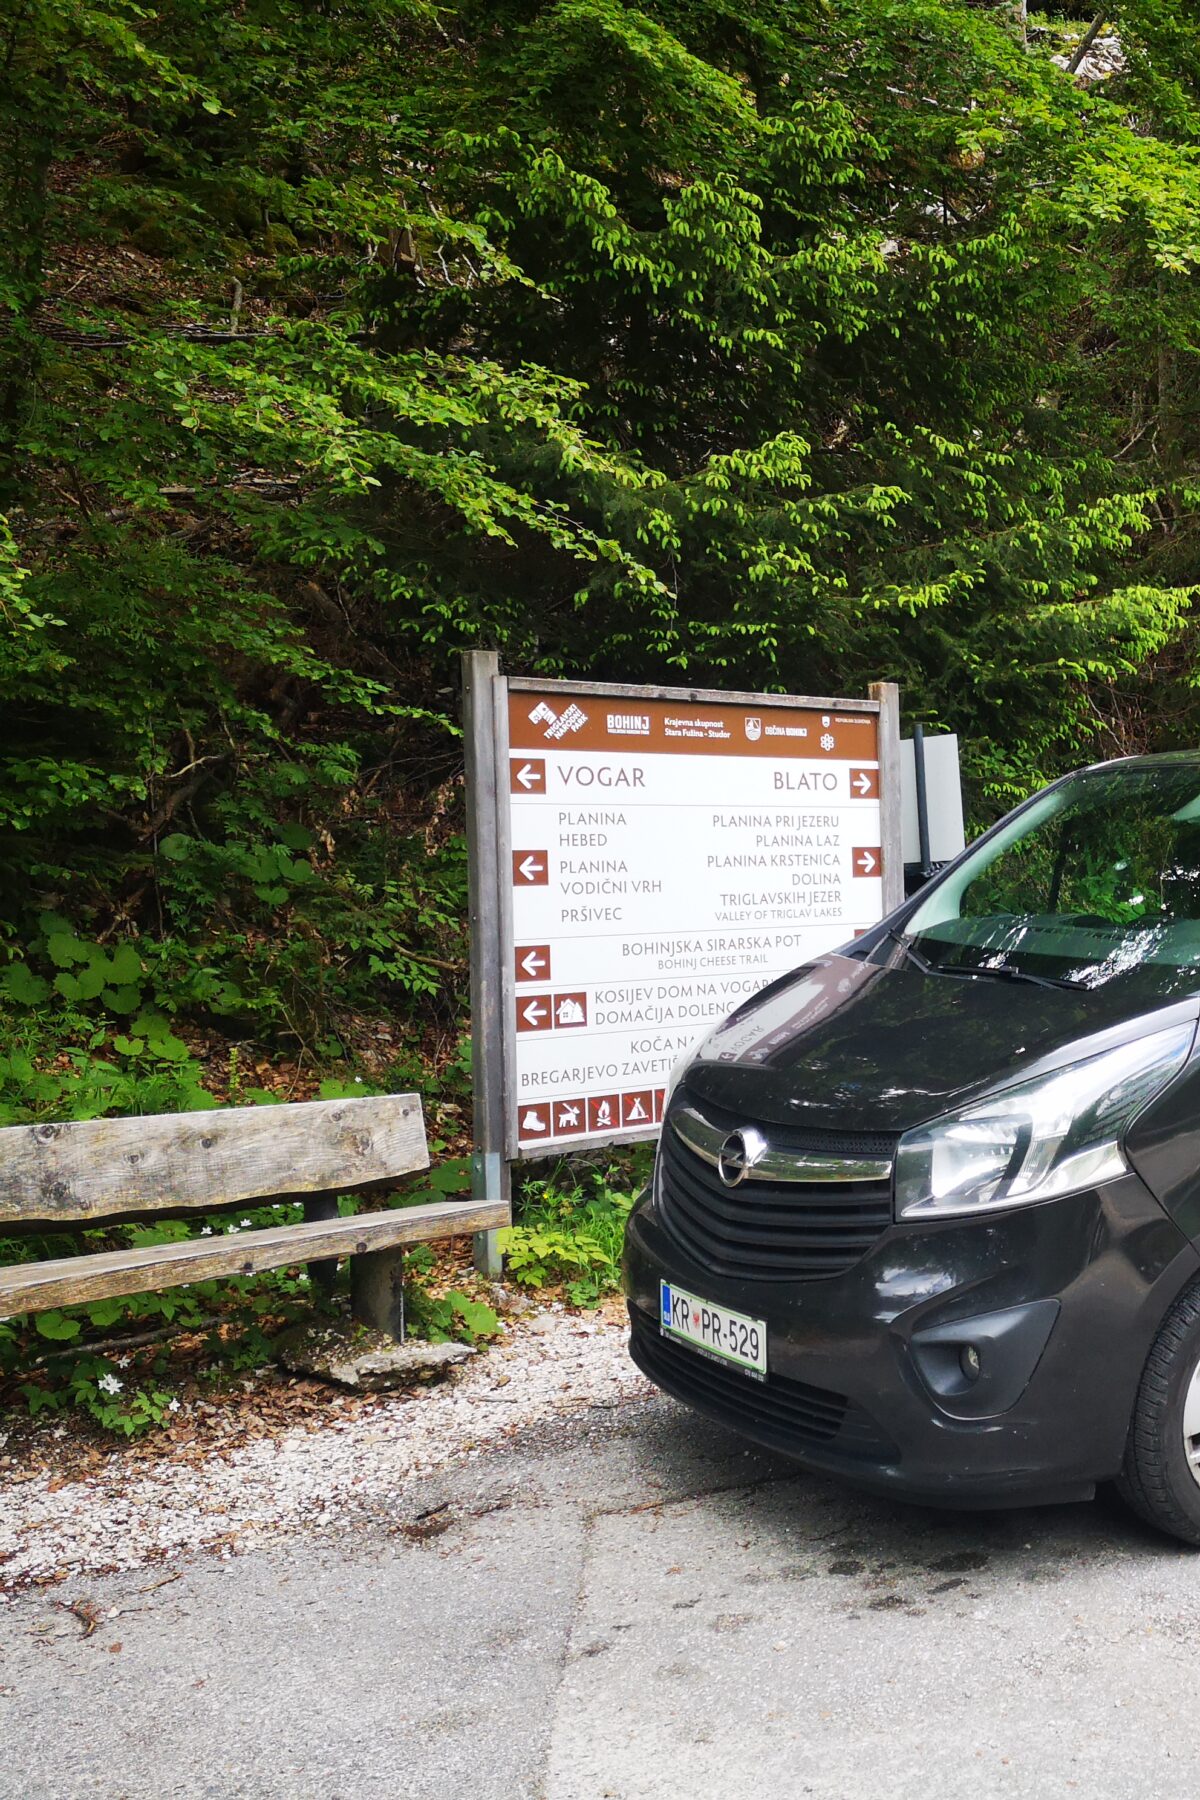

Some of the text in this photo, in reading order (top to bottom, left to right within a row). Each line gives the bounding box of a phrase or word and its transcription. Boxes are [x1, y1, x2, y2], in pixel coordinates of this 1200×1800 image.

[543, 703, 578, 739] TRIGLAVSKI
[553, 709, 583, 740] NARODNI
[570, 713, 589, 733] PARK
[606, 714, 650, 730] BOHINJ
[664, 717, 724, 729] Krajevna skupnost
[665, 728, 682, 737] Stara
[708, 730, 731, 739] Studor
[557, 766, 646, 787] VOGAR
[774, 771, 838, 791] BLATO
[559, 812, 627, 825] PLANINA
[712, 815, 839, 831] PLANINA PRI JEZERU
[559, 833, 608, 847] HEBED
[756, 834, 840, 847] PLANINA LAZ
[560, 860, 628, 874] PLANINA
[707, 854, 841, 868] PLANINA KRSTENICA
[560, 878, 662, 895] VODIČNI VRH
[792, 873, 842, 886] DOLINA
[720, 890, 842, 907] TRIGLAVSKIH JEZER
[561, 906, 623, 922] PRŠIVEC
[715, 907, 842, 921] VALLEY OF TRIGLAV LAKES
[622, 934, 802, 957] BOHINJSKA SIRARSKA POT
[657, 953, 768, 970] BOHINJ CHEESE TRAIL
[595, 979, 774, 1006] KOSIJEV DOM NA VOGAR
[595, 1005, 674, 1025] DOMAČIJA
[630, 1036, 673, 1054] KOČA
[521, 1064, 618, 1087] BREGARJEVO
[671, 1294, 690, 1332] KR
[701, 1308, 759, 1361] PR-529
